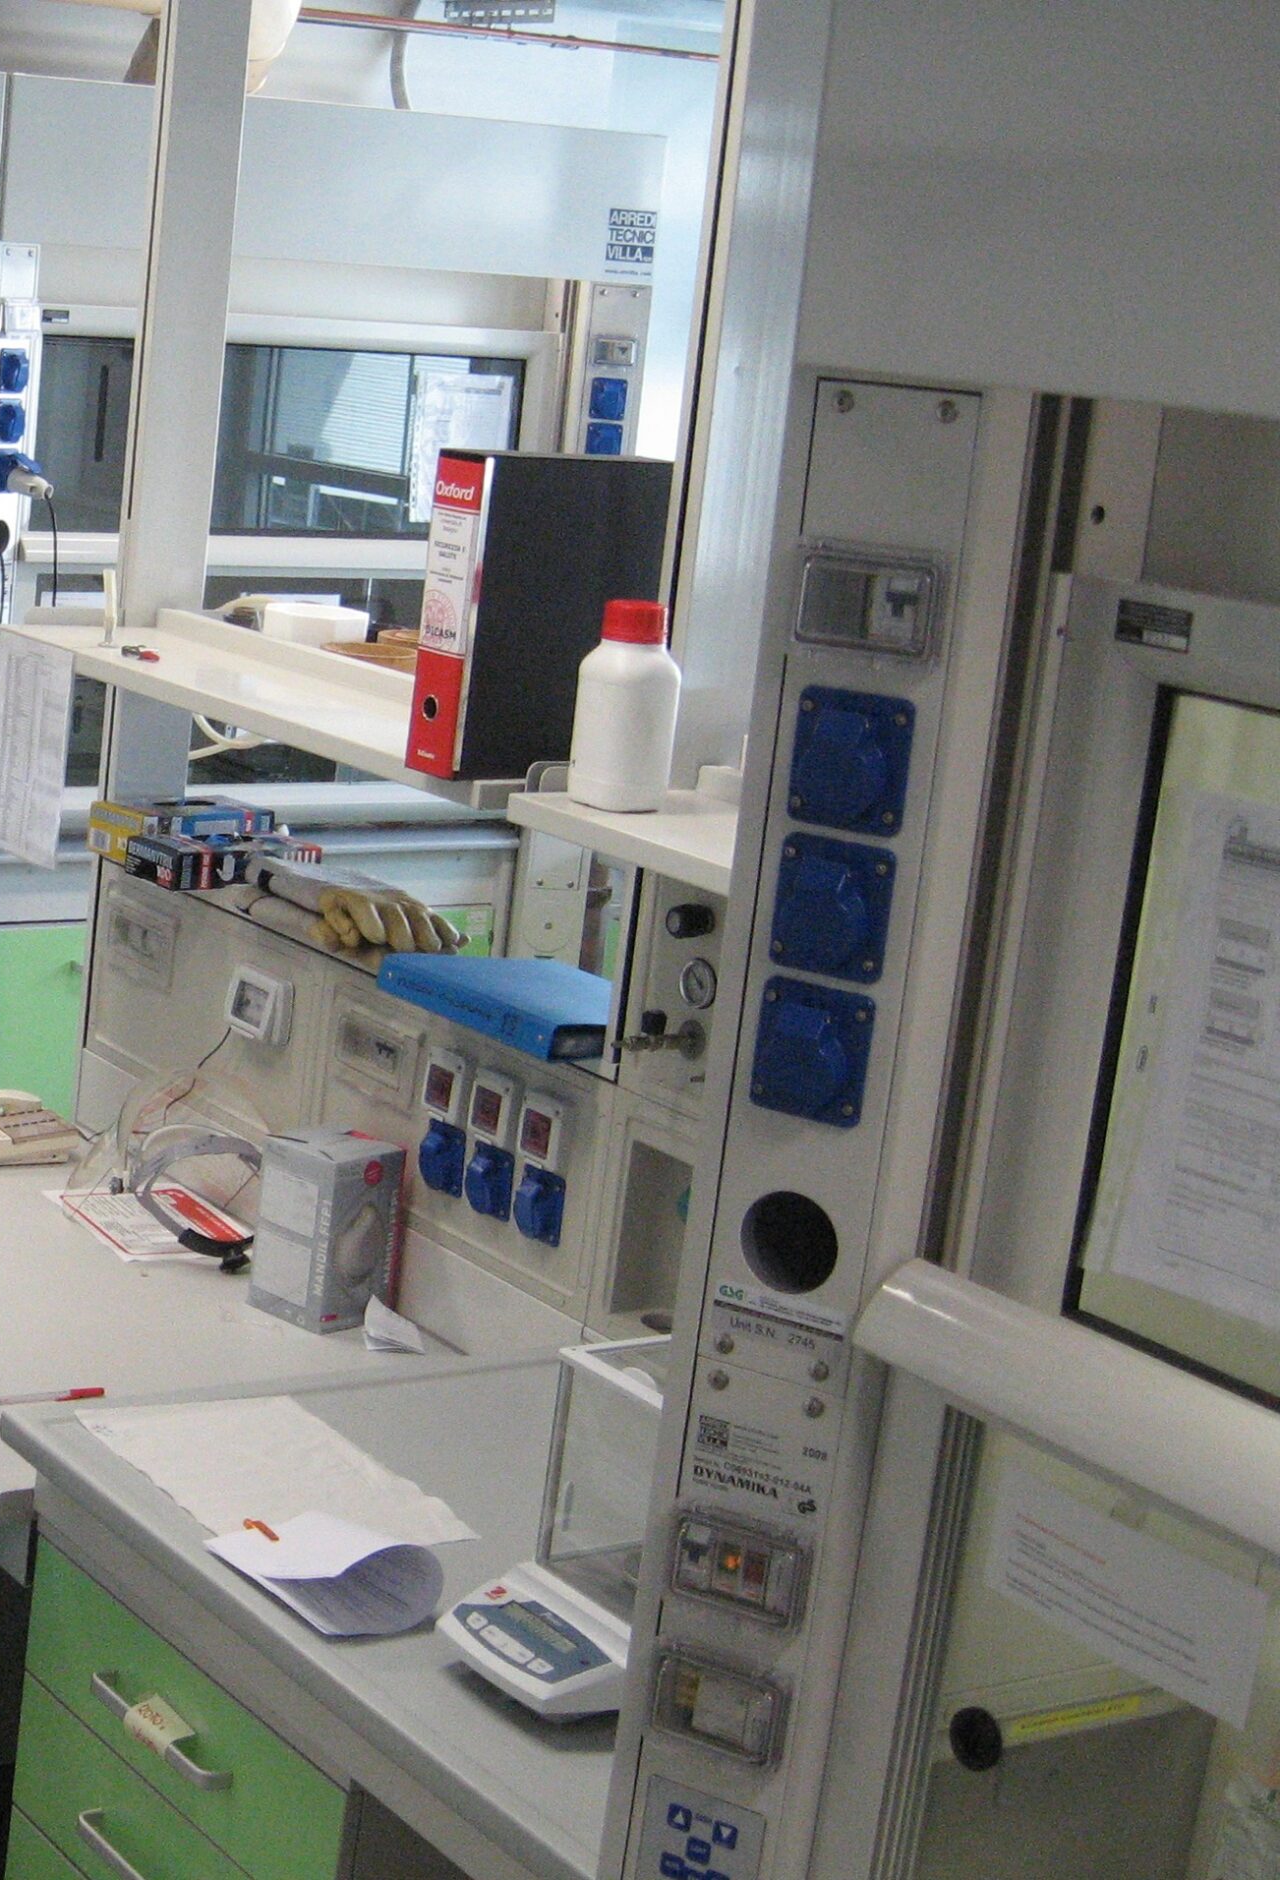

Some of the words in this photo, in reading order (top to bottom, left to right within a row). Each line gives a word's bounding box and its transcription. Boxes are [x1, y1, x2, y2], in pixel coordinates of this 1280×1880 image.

[609, 210, 657, 227] ARREDI
[608, 227, 656, 244] TECNICI
[606, 244, 644, 262] VILLA
[435, 480, 475, 501] Oxford
[693, 1464, 778, 1499] DYNAMIKA
